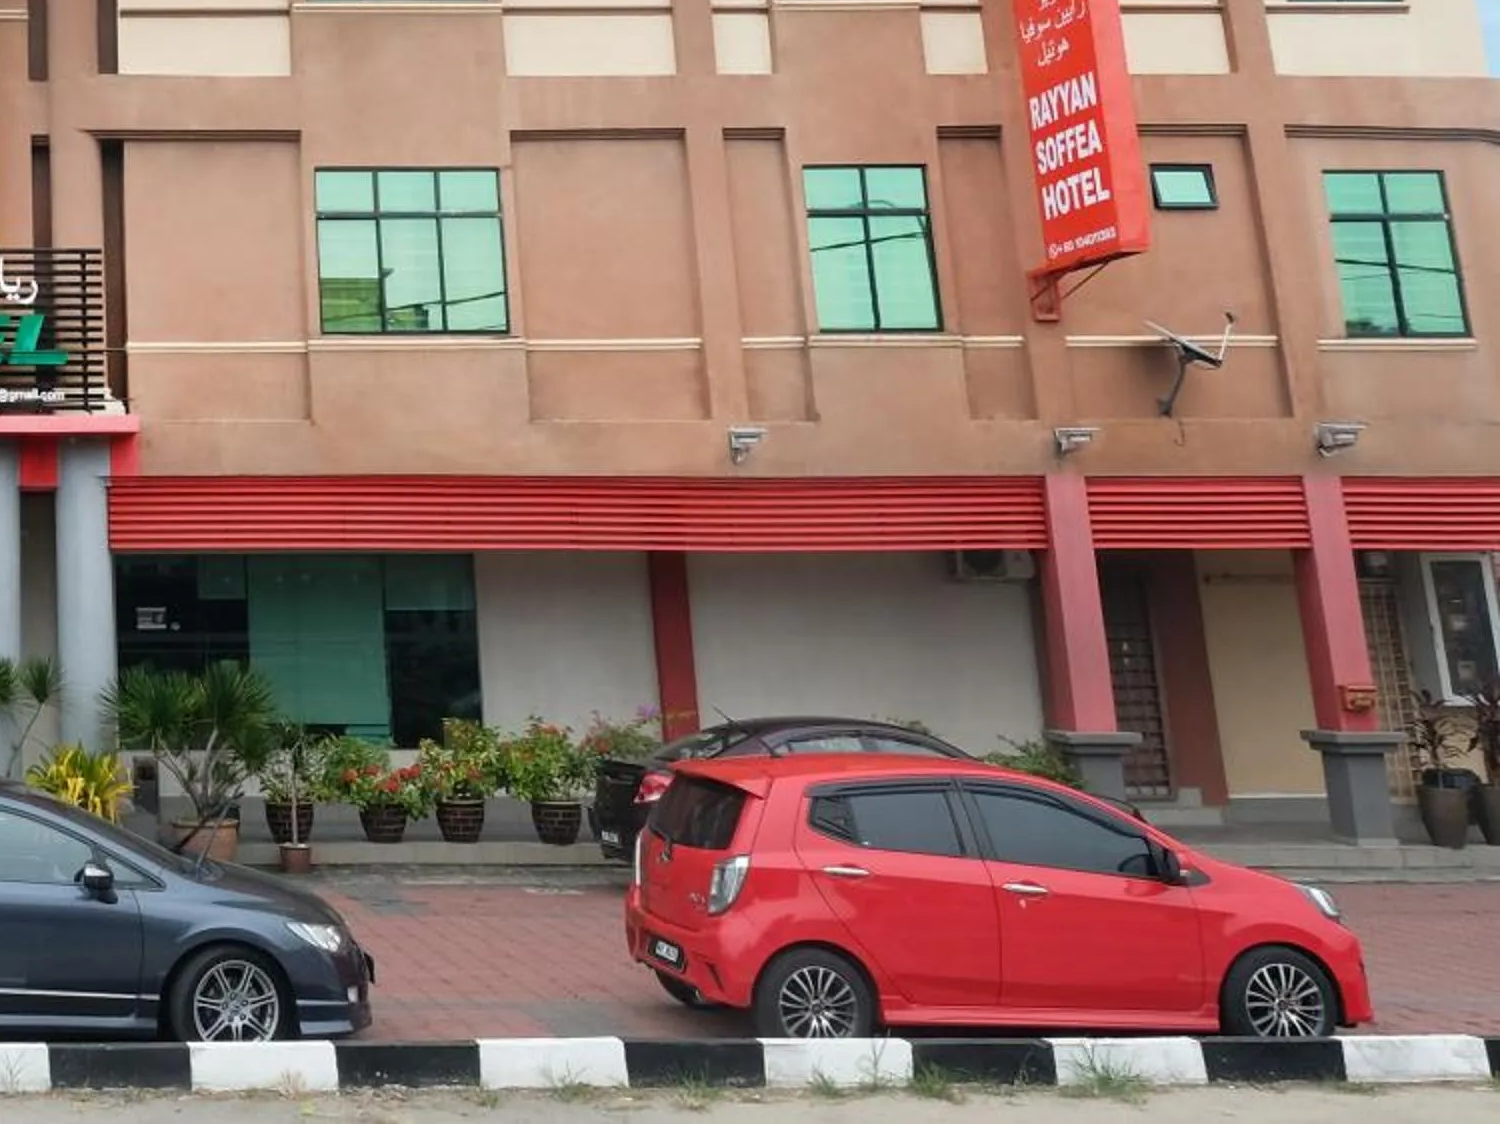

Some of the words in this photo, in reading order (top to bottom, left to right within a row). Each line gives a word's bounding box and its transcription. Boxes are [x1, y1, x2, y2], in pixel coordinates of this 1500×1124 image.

[1029, 71, 1097, 131] RAYYAN
[1035, 118, 1103, 175] SOFFEA
[1042, 167, 1111, 221] HOTEL
